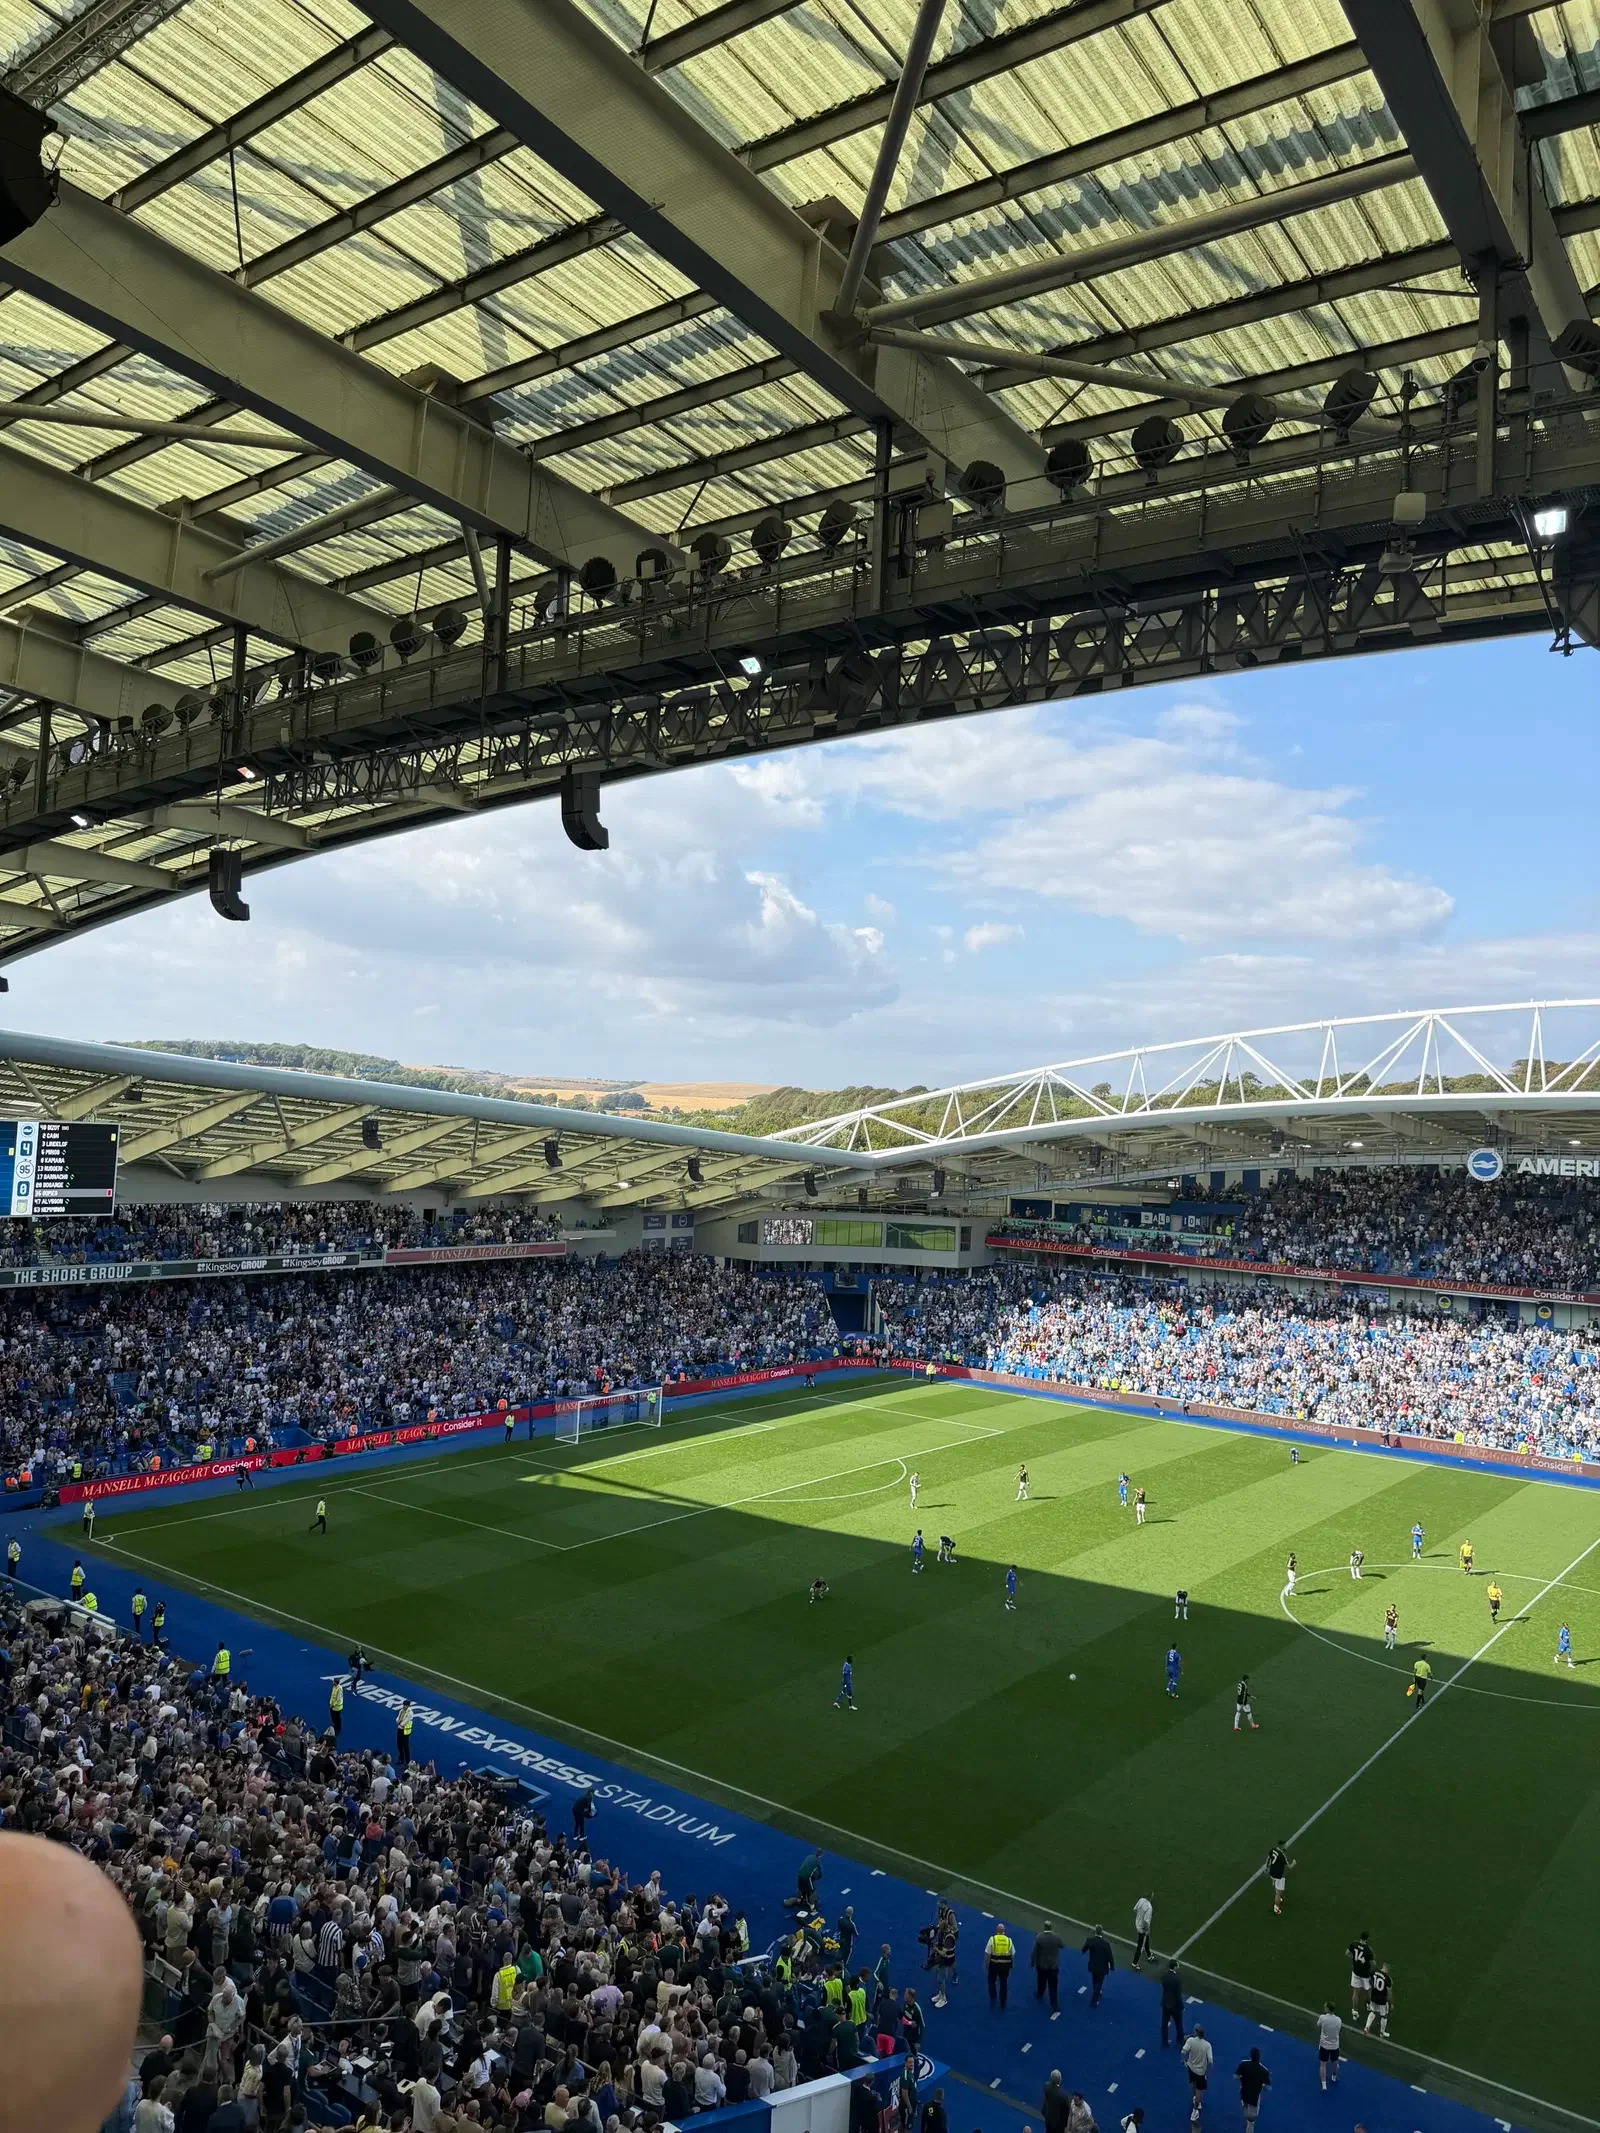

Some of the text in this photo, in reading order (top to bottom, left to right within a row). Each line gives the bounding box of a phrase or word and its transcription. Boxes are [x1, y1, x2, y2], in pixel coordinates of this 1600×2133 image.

[22, 1142, 30, 1155] 4
[20, 1165, 31, 1174] 95
[1517, 1157, 1600, 1178] AMERI
[20, 1183, 27, 1195] 0
[429, 1249, 475, 1261] MANSELL
[1008, 1240, 1042, 1249] MANSELL
[1042, 1243, 1086, 1252] McTAGGART
[1091, 1248, 1121, 1256] Consider
[14, 1266, 132, 1283] THE SHORE GROUP
[1195, 1258, 1338, 1278] MANSELL McTAGGART Consider it
[1415, 1279, 1462, 1290] MANSELL
[1464, 1284, 1526, 1296] McTAGGART
[1533, 1290, 1576, 1300] Consider
[838, 1358, 871, 1366] MANSELL
[710, 1378, 737, 1388] MANSELL
[770, 1370, 790, 1378] Consider
[1084, 1390, 1113, 1400] Consider
[1115, 1393, 1120, 1401] it
[443, 1419, 475, 1432] Consider
[477, 1418, 482, 1426] it
[1293, 1421, 1328, 1433] Consider
[1330, 1426, 1336, 1435] it
[1532, 1458, 1573, 1471] Consider
[1576, 1464, 1583, 1473] it
[82, 1476, 141, 1498] MANSELL
[144, 1466, 210, 1487] McTAGGART
[255, 1458, 262, 1468] it
[454, 1727, 604, 1789] EXPRESS
[594, 1784, 736, 1846] STADIUM
[1354, 1948, 1366, 1964] 14
[1373, 1974, 1385, 1991] 10
